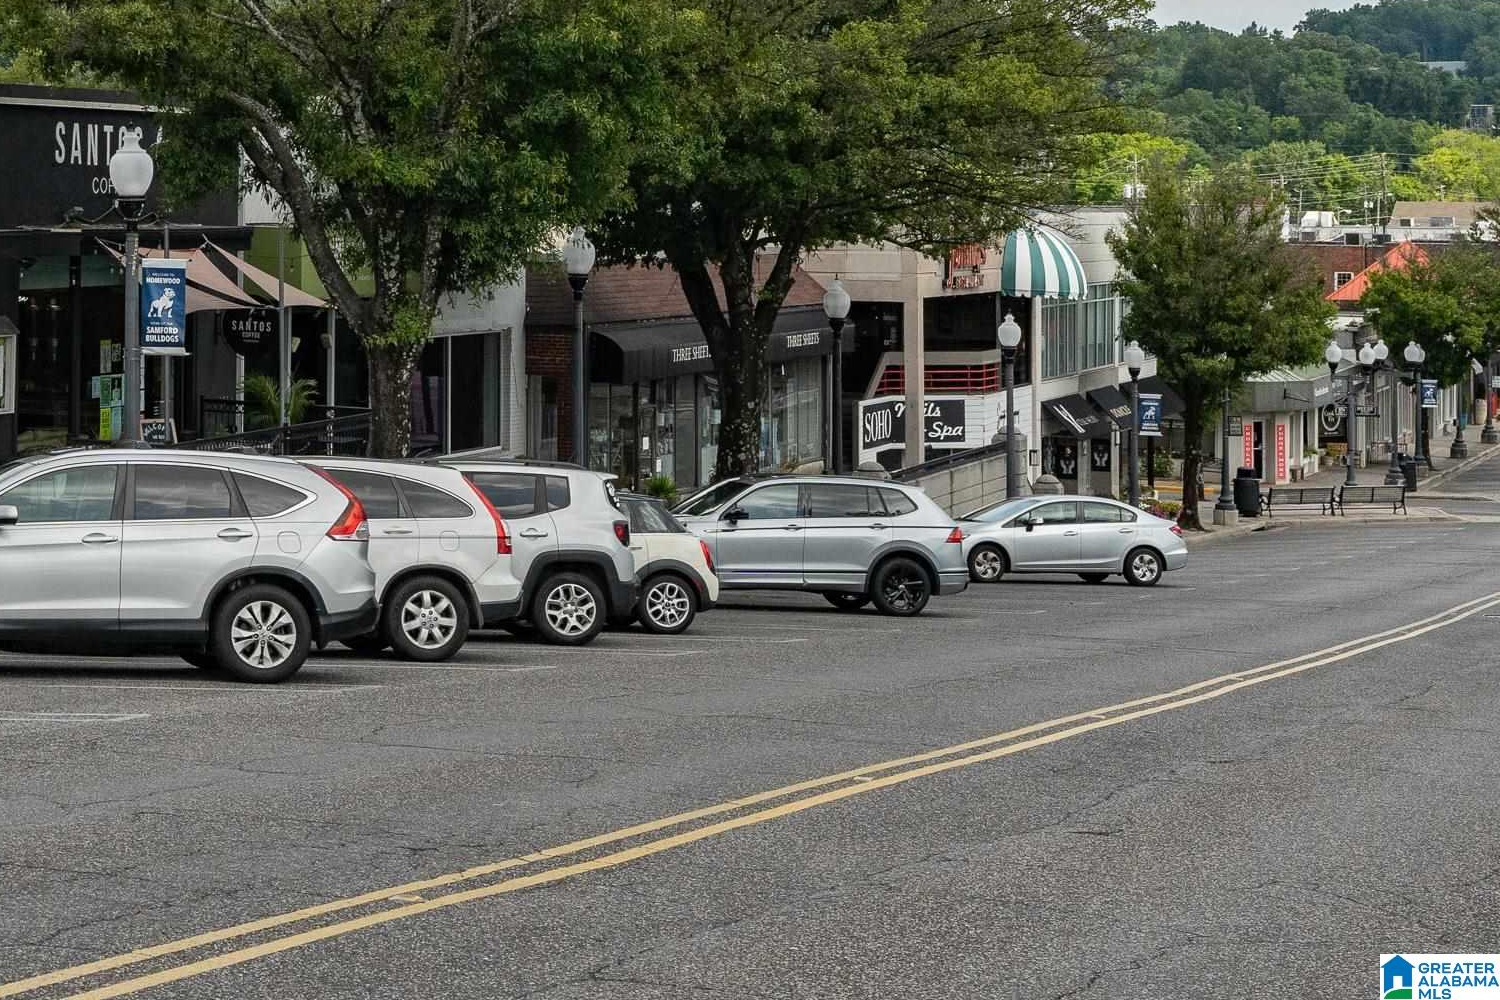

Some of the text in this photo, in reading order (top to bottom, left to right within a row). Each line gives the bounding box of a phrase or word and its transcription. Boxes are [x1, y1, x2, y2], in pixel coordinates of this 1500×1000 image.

[55, 121, 143, 166] SANT
[146, 276, 181, 285] HOMEWOOD
[146, 326, 179, 334] SAMFORD
[231, 319, 272, 332] SANTOS
[145, 334, 180, 343] BULLDOGS
[787, 331, 820, 349] THREE SHEETS
[672, 344, 712, 363] THREE SHEET
[864, 402, 941, 443] SOHO Nils
[928, 421, 964, 440] Spa
